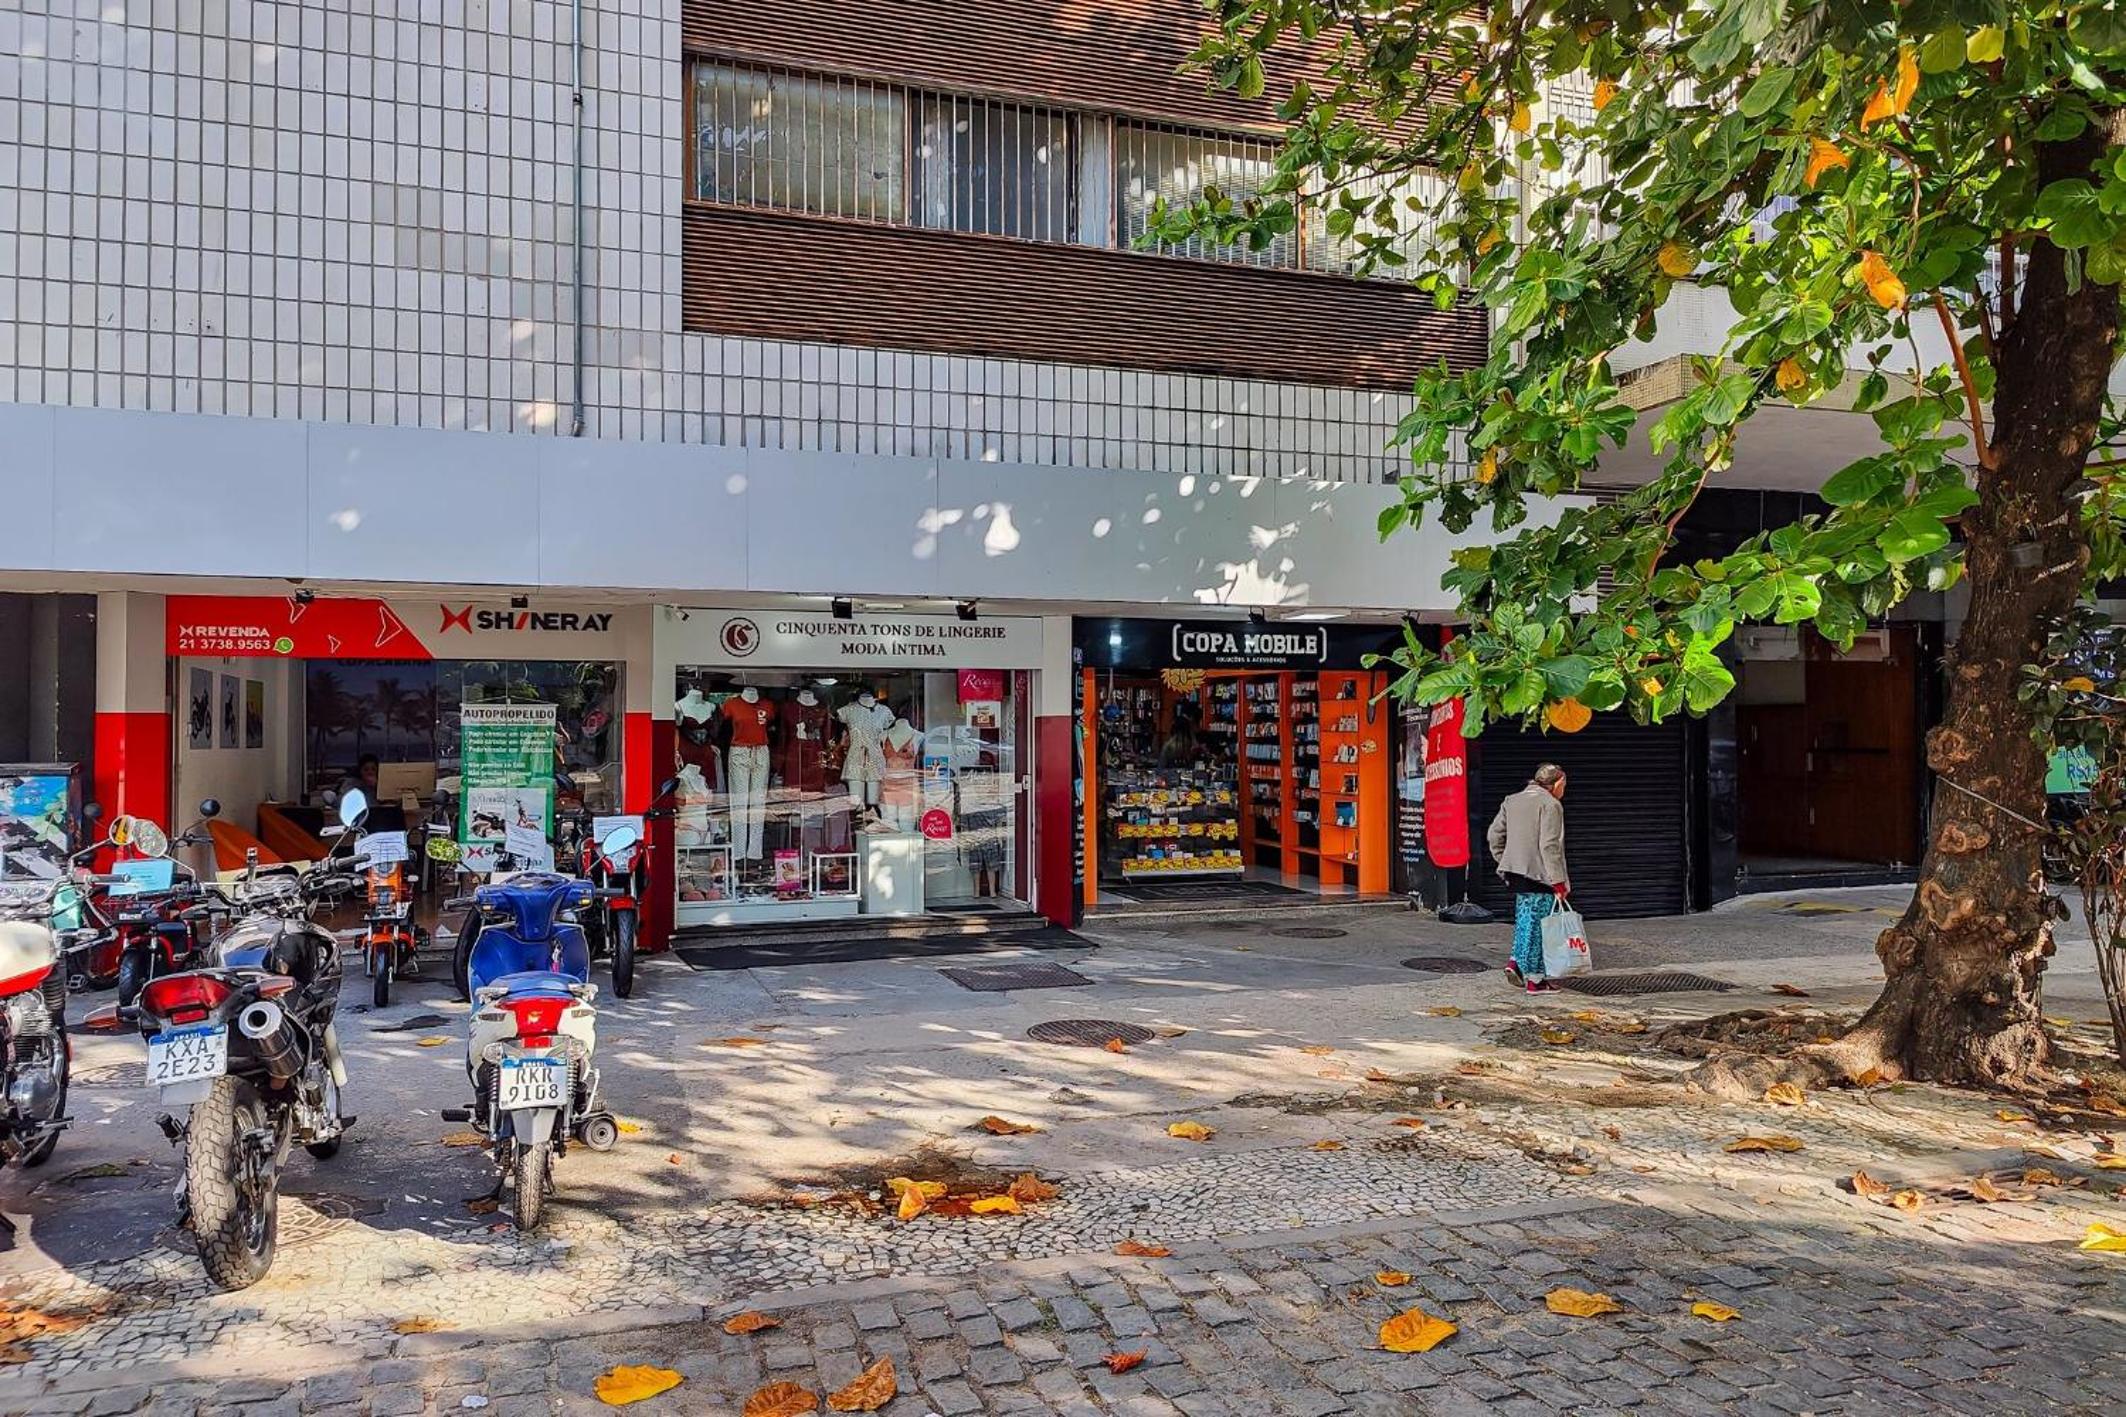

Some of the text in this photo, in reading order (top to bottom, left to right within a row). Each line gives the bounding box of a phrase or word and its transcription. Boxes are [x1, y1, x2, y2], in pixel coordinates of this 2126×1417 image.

[477, 610, 613, 632] SHINERAY
[195, 626, 270, 637] REVENDA
[776, 622, 1006, 638] CINQUENTA TONS DE LINGERIE
[179, 639, 271, 650] 21 3738.9563
[841, 641, 946, 656] MODA ÍNTIMA
[1183, 633, 1317, 654] COPA MOBILE
[463, 709, 554, 719] AUTOPROPELIDO
[166, 1038, 208, 1059] KXA
[157, 1054, 215, 1079] 2E23
[516, 1068, 552, 1084] RKR
